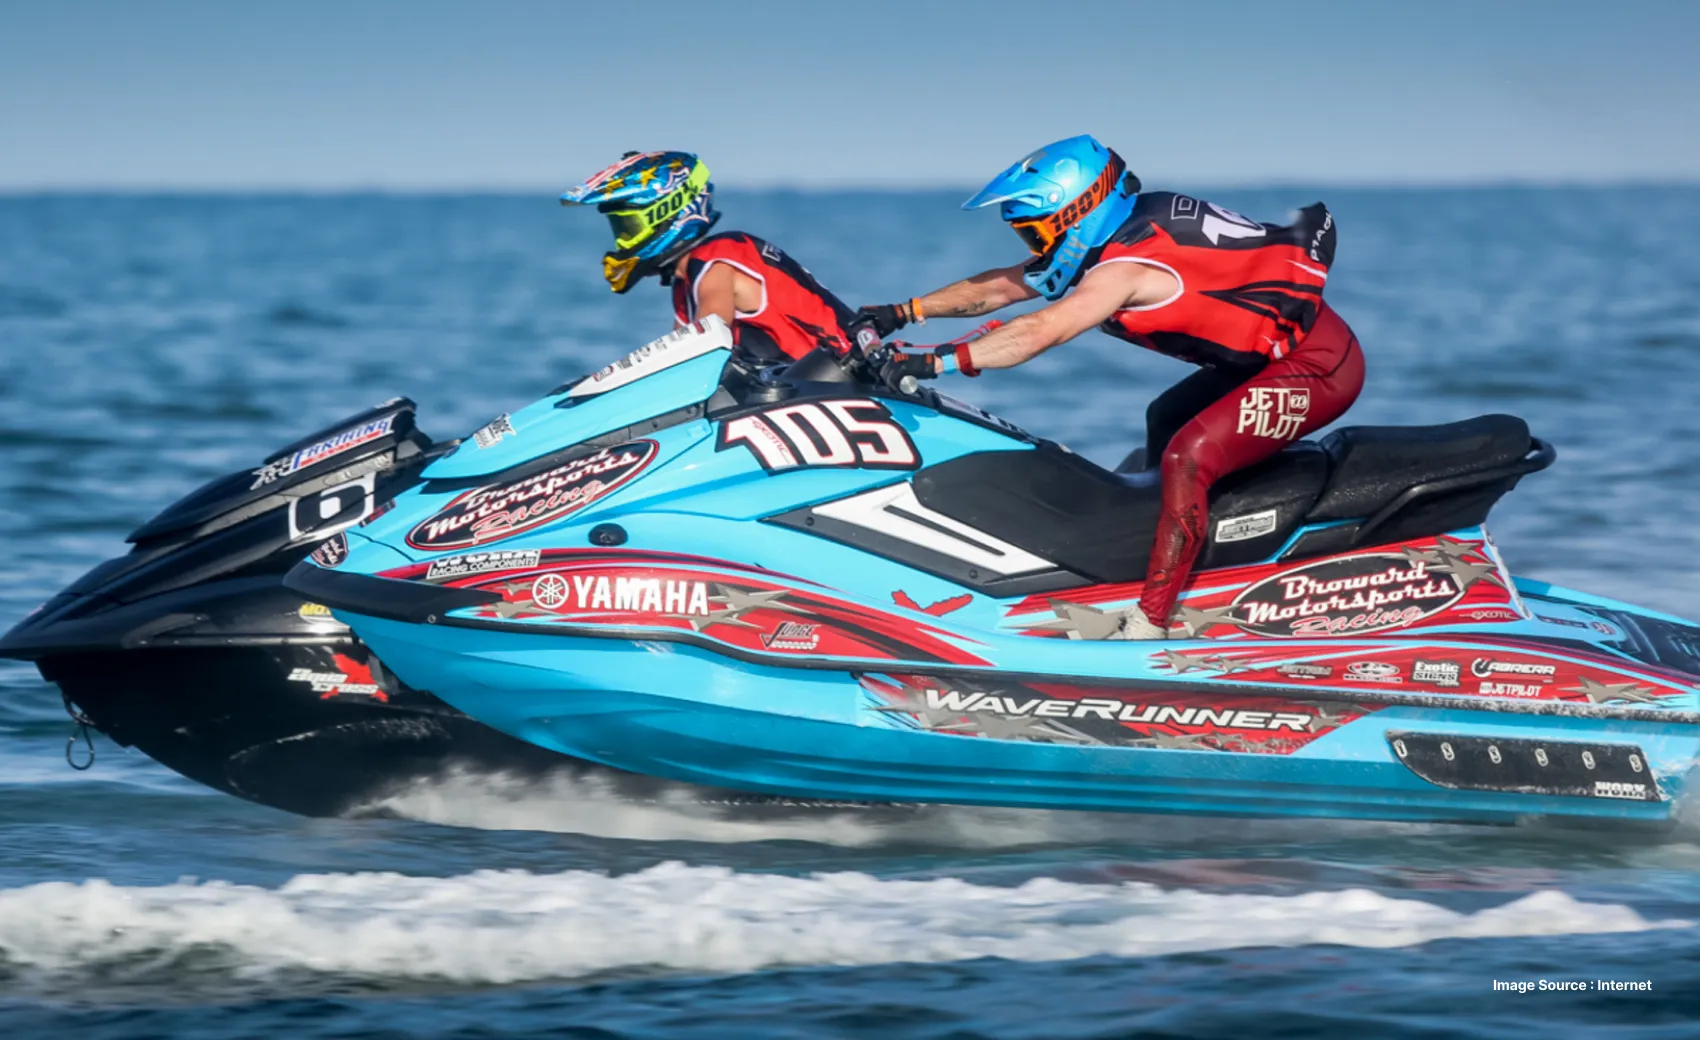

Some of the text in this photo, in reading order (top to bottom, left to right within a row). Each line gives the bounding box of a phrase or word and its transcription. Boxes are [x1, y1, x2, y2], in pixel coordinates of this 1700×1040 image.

[1239, 387, 1290, 414] JET
[725, 400, 916, 470] 105
[1236, 409, 1306, 441] PILOT
[424, 450, 641, 543] Motorsports
[470, 479, 606, 544] Racing
[431, 558, 536, 576] RACING COMPONENTS
[1279, 561, 1428, 600] Broward
[572, 575, 709, 616] YAMAHA
[1243, 579, 1456, 625] Motorsports
[1289, 605, 1425, 637] Racing
[1415, 661, 1460, 673] Exotic
